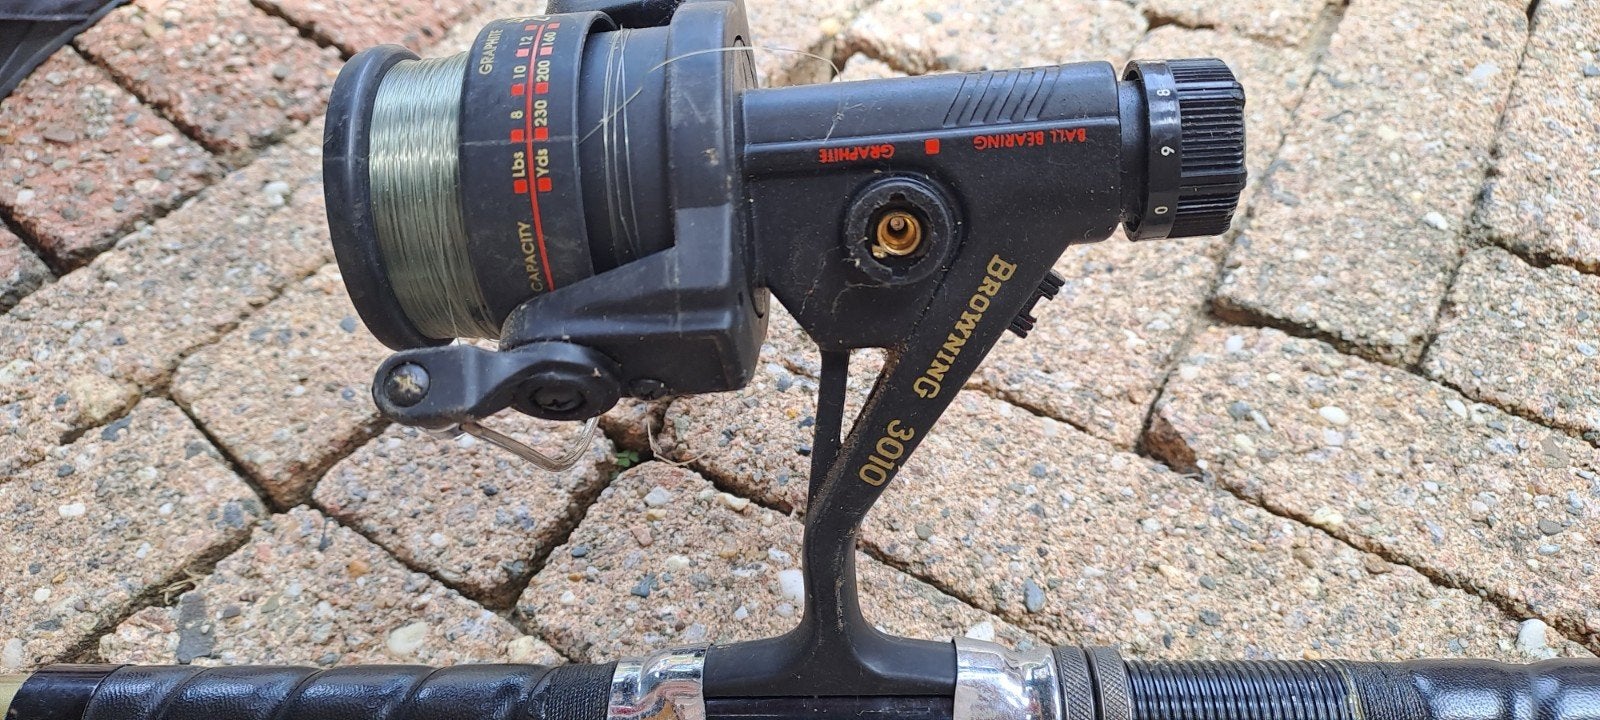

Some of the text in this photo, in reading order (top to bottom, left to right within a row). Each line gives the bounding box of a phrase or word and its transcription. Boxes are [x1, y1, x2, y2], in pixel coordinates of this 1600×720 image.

[479, 29, 503, 75] GRAPHITE
[535, 31, 557, 177] Yds 230 200 160
[511, 35, 533, 178] Lbs 8 10 12
[819, 128, 1087, 164] BALL BEARING GRAPHITE
[517, 221, 543, 292] CAPACITY
[859, 254, 1018, 487] BROWNING 3010
